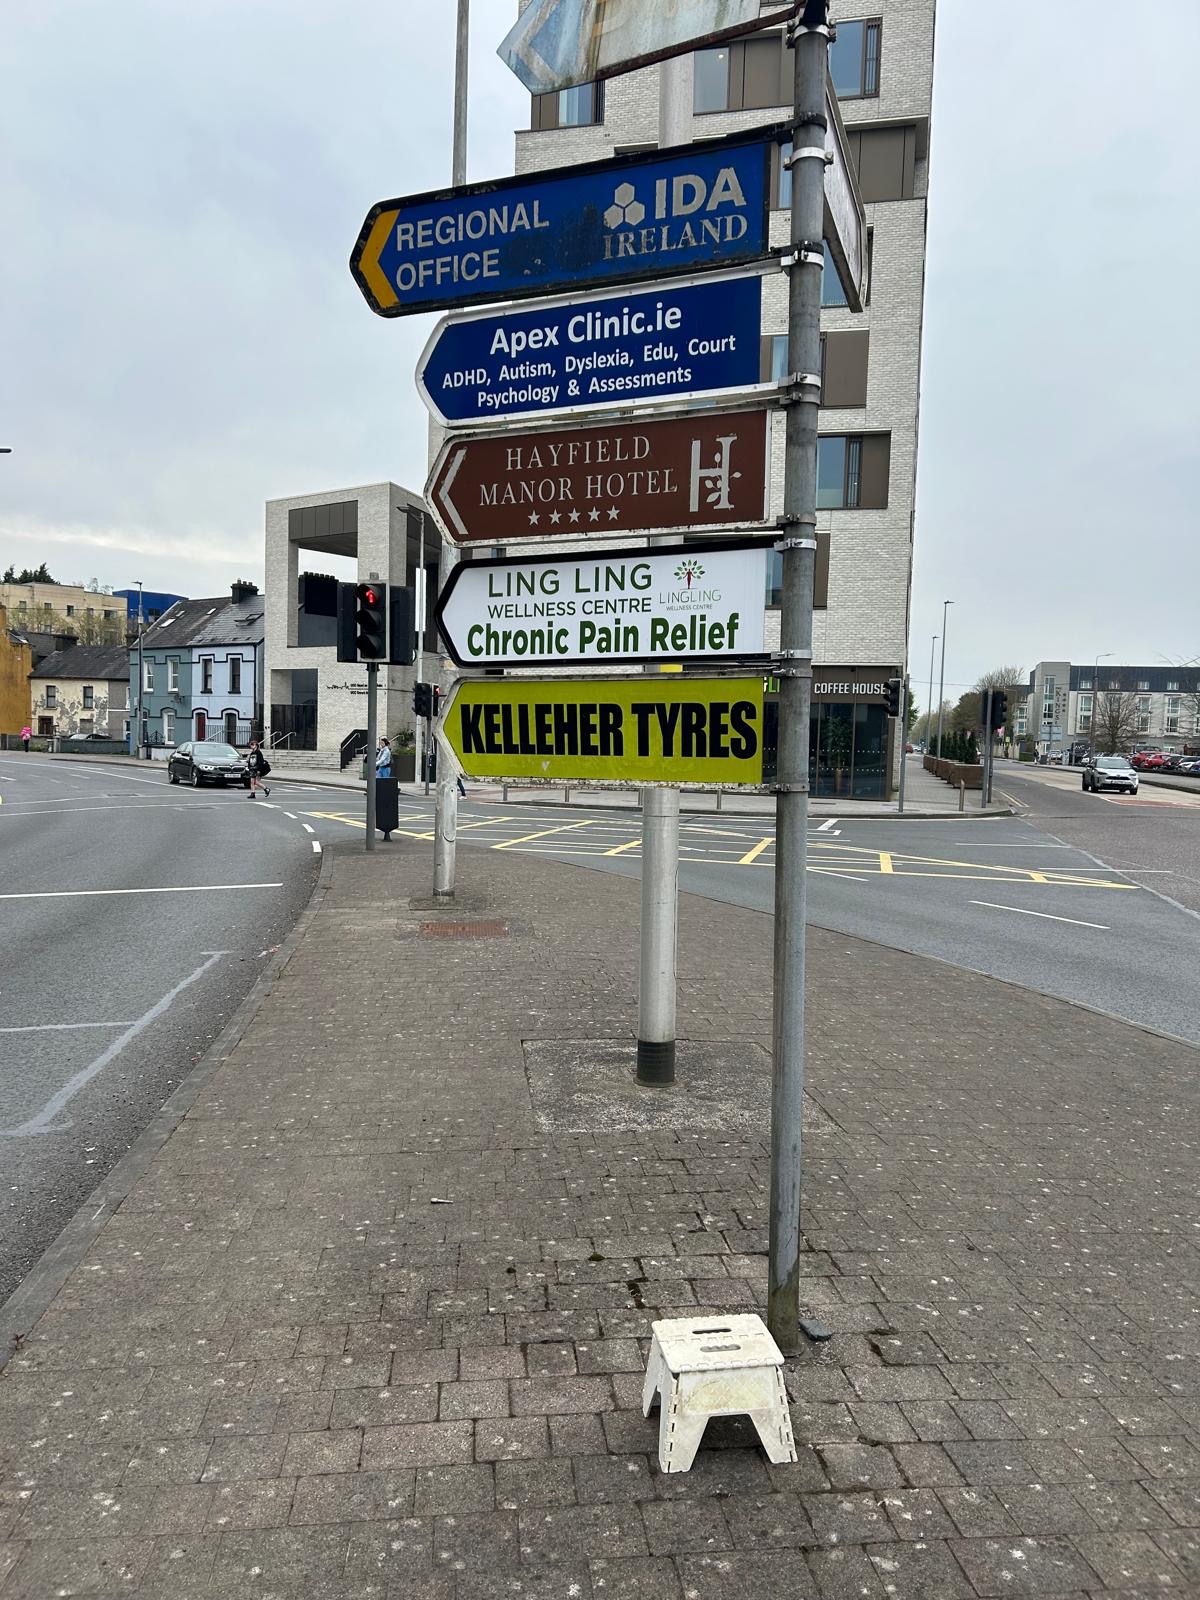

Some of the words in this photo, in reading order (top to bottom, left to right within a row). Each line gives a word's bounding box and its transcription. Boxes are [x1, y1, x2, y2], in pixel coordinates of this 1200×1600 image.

[655, 167, 747, 220] IDA
[396, 199, 550, 251] REGIONAL
[602, 214, 749, 260] IRELAND
[395, 249, 500, 291] OFFICE
[490, 323, 559, 358] Apex
[567, 302, 683, 344] Clinic.ie
[442, 368, 491, 389] ADHD,
[499, 359, 556, 382] Autism,
[565, 349, 634, 375] Dyslexia,
[643, 342, 679, 363] Edu,
[688, 334, 736, 356] Court
[477, 383, 559, 409] Psychology
[567, 380, 580, 396] &
[588, 367, 692, 394] Assessments
[506, 436, 651, 471] HAYFIELD
[480, 477, 574, 506] MANOR
[585, 468, 678, 499] HOTEL
[488, 569, 560, 598] LING
[575, 563, 652, 594] LING
[659, 589, 722, 604] LINGLING
[487, 600, 576, 618] WELLNESS
[582, 597, 652, 615] CENTRE
[467, 621, 569, 657] Chronic
[579, 618, 639, 653] Pain
[650, 612, 740, 652] Relief
[814, 682, 849, 694] COFFEE
[853, 683, 887, 695] HOUSE
[460, 703, 624, 757] KELLEHER
[631, 701, 758, 760] TYRES
